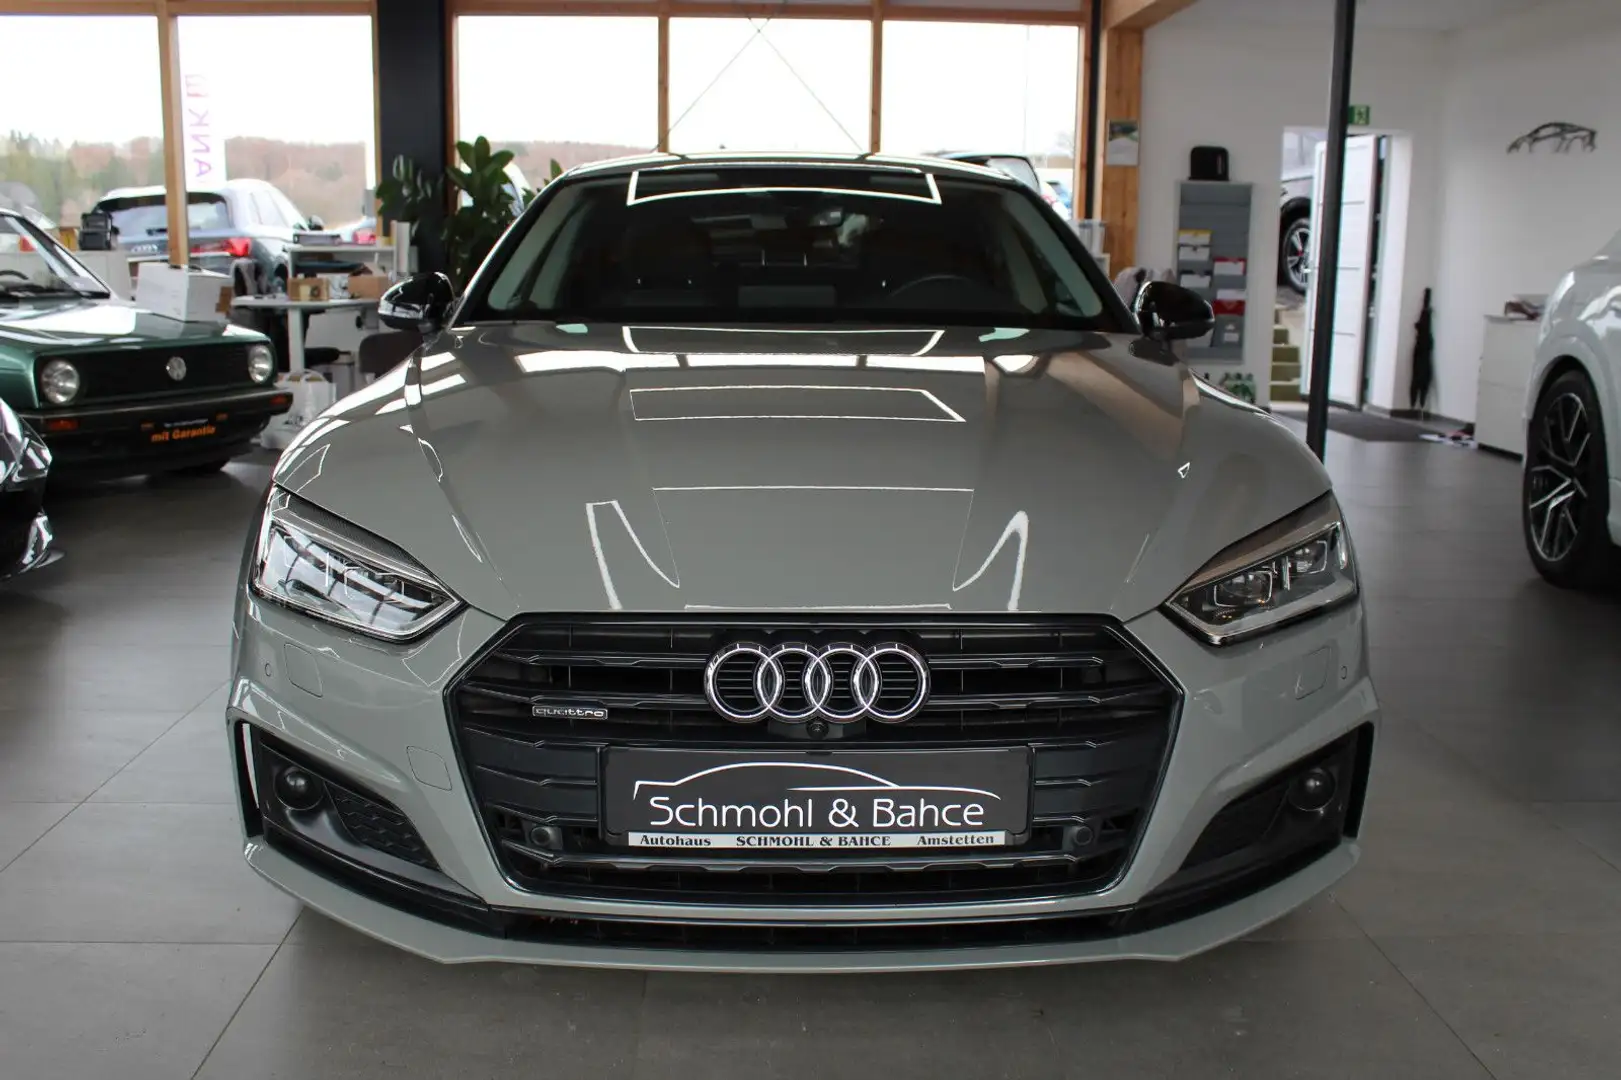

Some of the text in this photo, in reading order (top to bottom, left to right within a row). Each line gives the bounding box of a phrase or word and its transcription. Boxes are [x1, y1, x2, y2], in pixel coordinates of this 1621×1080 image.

[535, 708, 604, 717] quattro
[650, 796, 984, 828] Schmohl & Bahce
[640, 834, 994, 847] Autohaus SCHMOHL & BAHCE Amstetten
